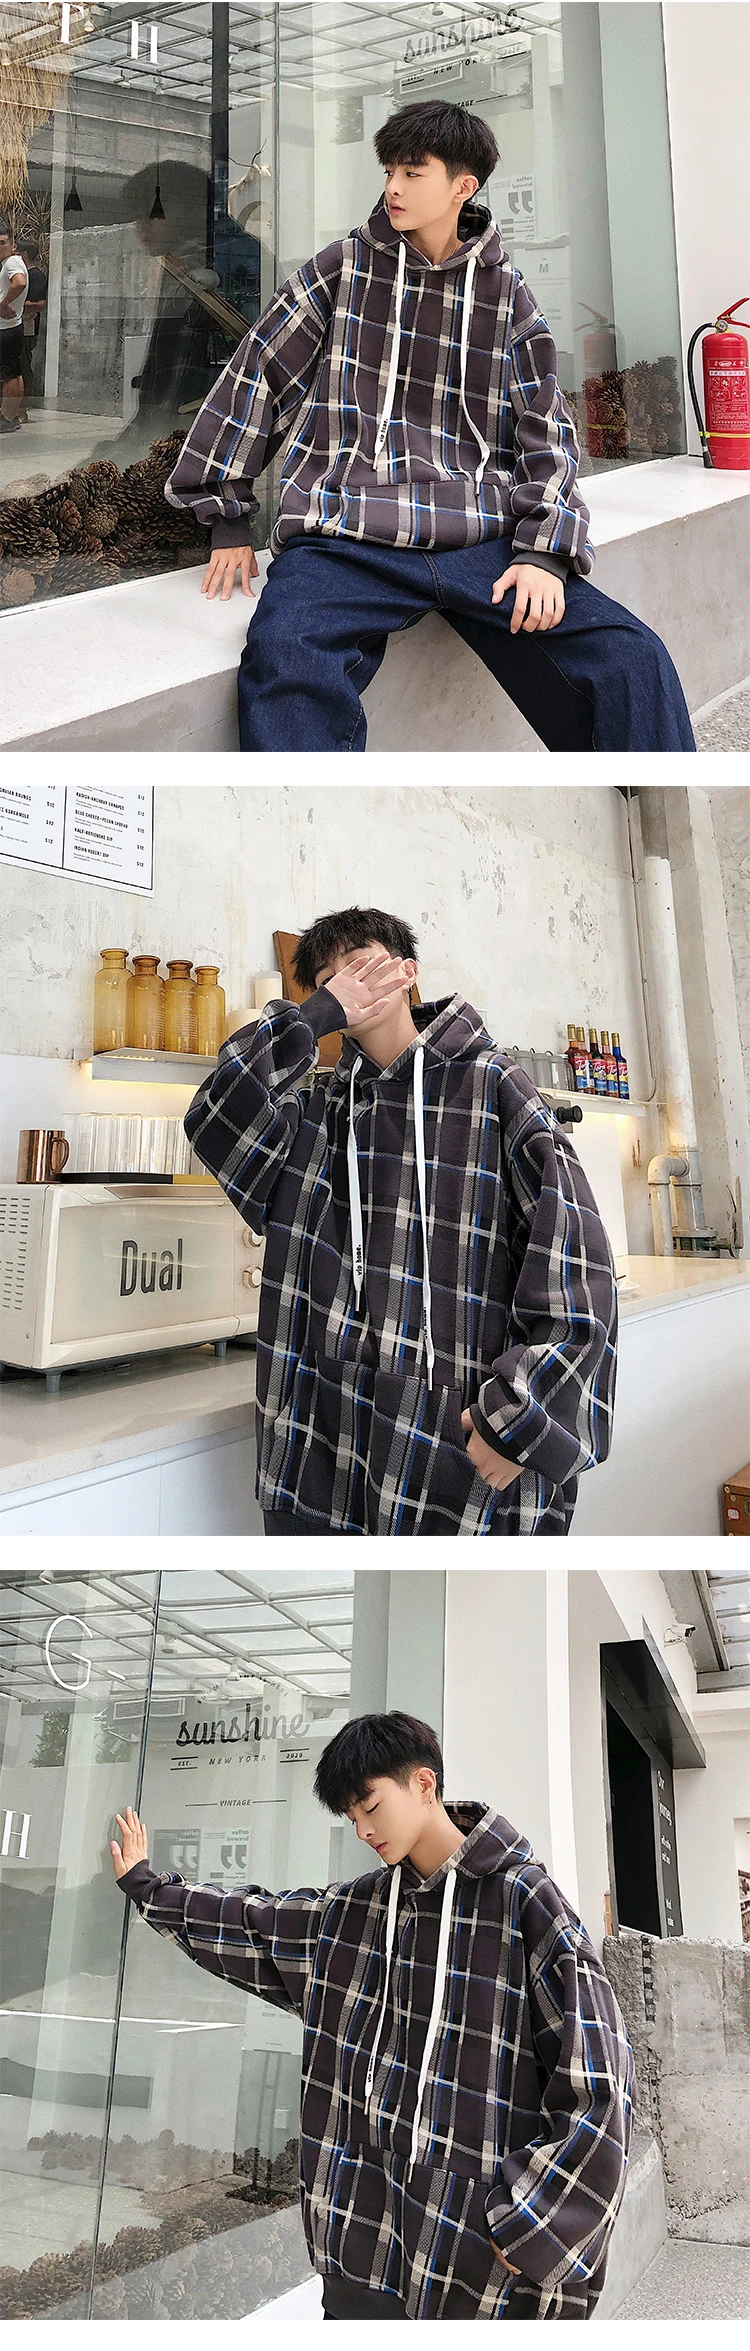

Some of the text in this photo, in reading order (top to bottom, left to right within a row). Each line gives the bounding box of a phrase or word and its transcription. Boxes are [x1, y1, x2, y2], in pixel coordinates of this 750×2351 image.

[48, 2, 161, 66] T H
[404, 9, 524, 63] sunshine
[433, 65, 453, 75] NEW
[120, 1238, 183, 1297] Dual
[176, 1703, 310, 1747] sunshine
[208, 1754, 267, 1766] NEW YORK
[219, 1799, 252, 1807] VINTAGE
[0, 1808, 33, 1860] H
